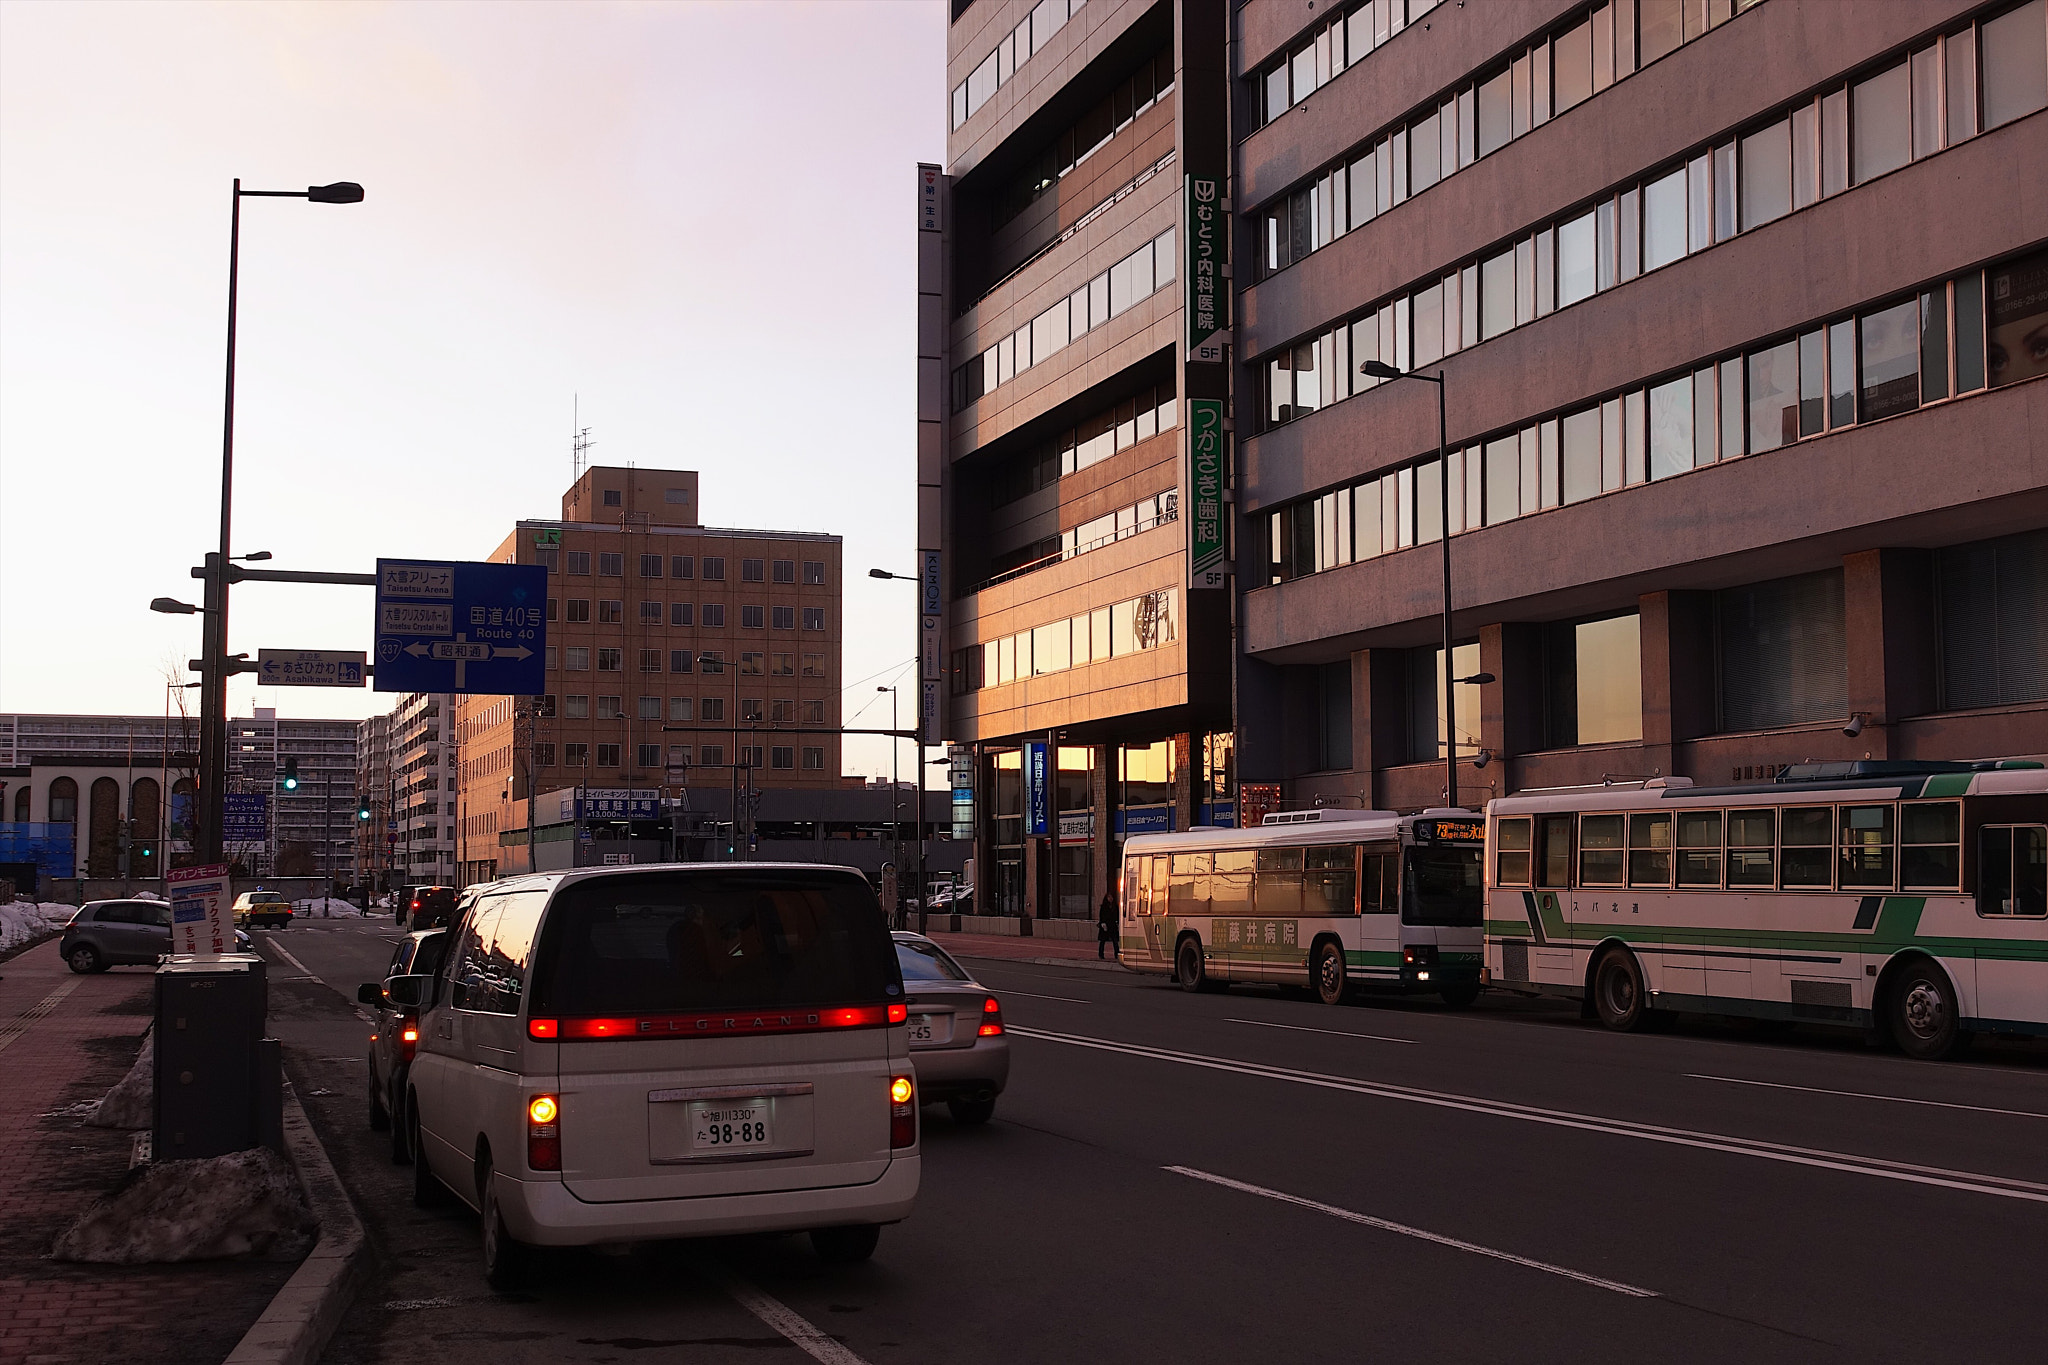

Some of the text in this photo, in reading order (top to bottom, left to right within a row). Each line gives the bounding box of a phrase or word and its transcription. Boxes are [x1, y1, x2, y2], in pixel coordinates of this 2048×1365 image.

[925, 185, 935, 228] 第一生命
[1197, 204, 1215, 330] むとう内科医院
[1201, 346, 1219, 358] 5F
[1196, 407, 1218, 543] つかさき歯科
[534, 530, 561, 543] JR
[388, 571, 449, 585] 大雪アリーナ
[927, 556, 939, 609] KUMON
[1206, 573, 1221, 584] 5F
[387, 584, 449, 594] Taisetsu Arena
[386, 608, 449, 621] 大雪クリスタルホール
[471, 606, 542, 627] 国道40号
[386, 622, 411, 630] Taisetsu
[413, 623, 434, 632] Crystal
[476, 628, 535, 640] Route 40
[382, 645, 399, 655] 237
[441, 645, 487, 657] 昭和通
[283, 661, 335, 674] あさひかわ
[286, 675, 333, 684] Asahikawa
[1034, 751, 1044, 826] 近畿日本ツーリスト
[1126, 813, 1168, 825] 近畿日本ツーリスト
[1436, 823, 1448, 838] 73
[1469, 823, 1486, 839] 永山
[168, 863, 228, 880] イオンモール
[1229, 921, 1295, 945] 藤井病院
[640, 1014, 819, 1031] ELGRAND
[697, 1122, 765, 1144] た 98-88
